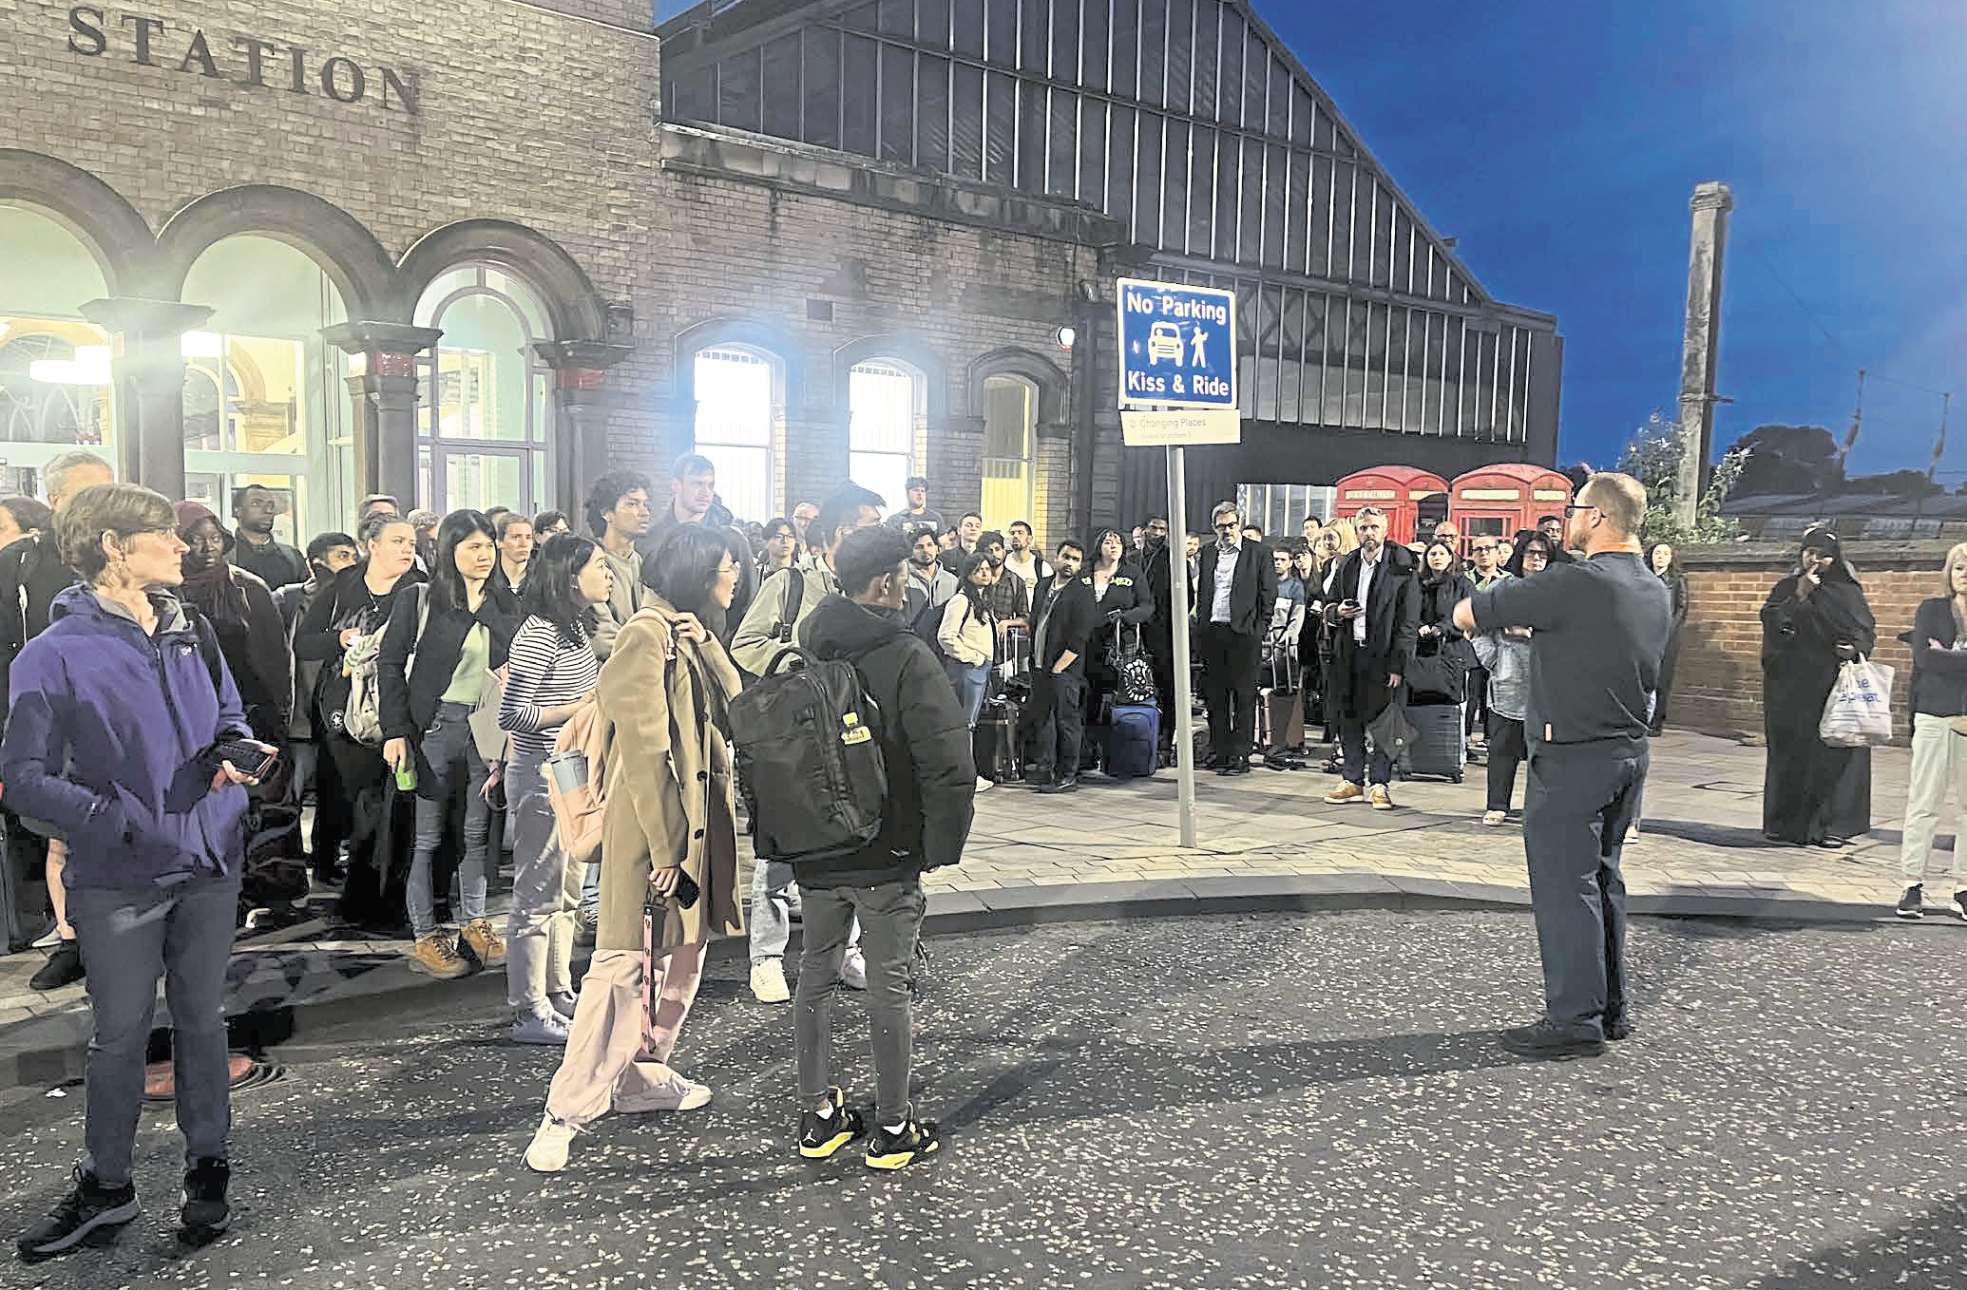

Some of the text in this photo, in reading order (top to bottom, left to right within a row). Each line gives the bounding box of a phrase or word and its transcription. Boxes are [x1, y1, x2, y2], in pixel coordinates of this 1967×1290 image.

[69, 6, 422, 115] STATION
[1127, 291, 1227, 326] No Parking
[1127, 369, 1230, 397] Kiss & Ride
[1180, 417, 1207, 429] Places
